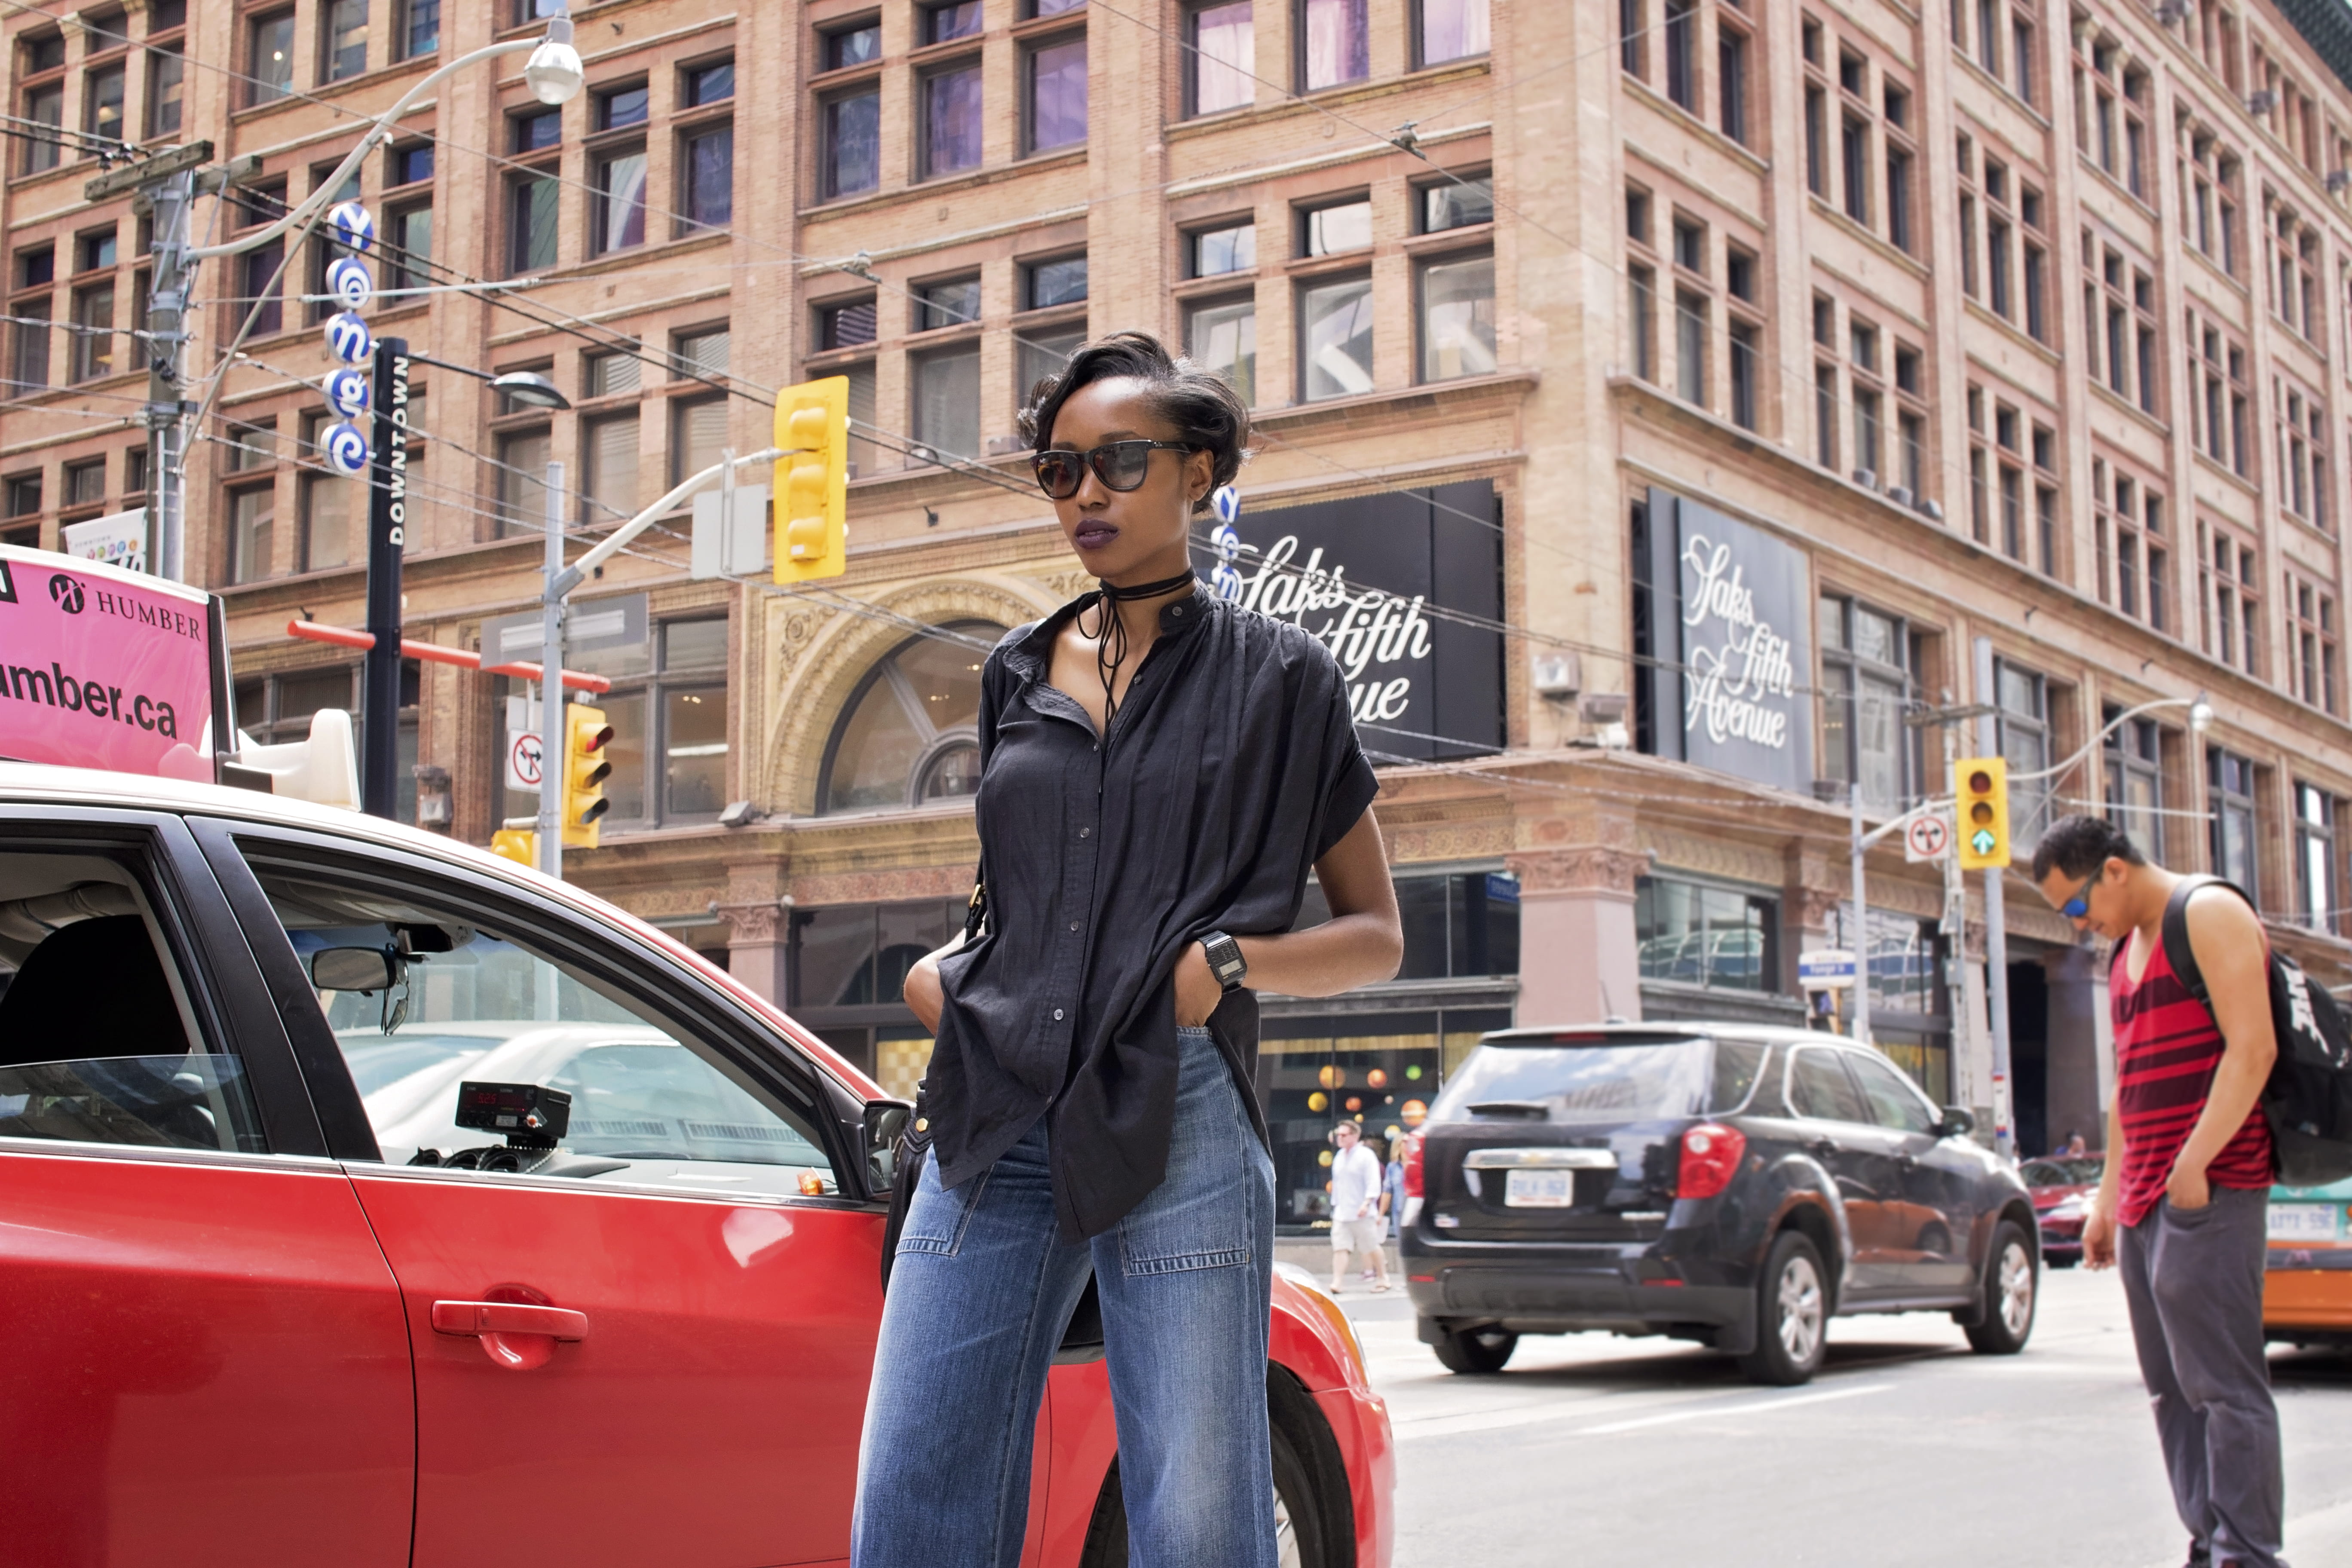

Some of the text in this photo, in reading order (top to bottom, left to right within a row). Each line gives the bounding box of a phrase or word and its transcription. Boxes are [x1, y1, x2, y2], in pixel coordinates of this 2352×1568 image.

[389, 356, 409, 545] DOWNTOWN
[95, 591, 201, 642] HUMBER
[1681, 534, 1755, 627] Saks
[1685, 646, 1786, 749] Avenue
[1721, 623, 1793, 701] Fifth
